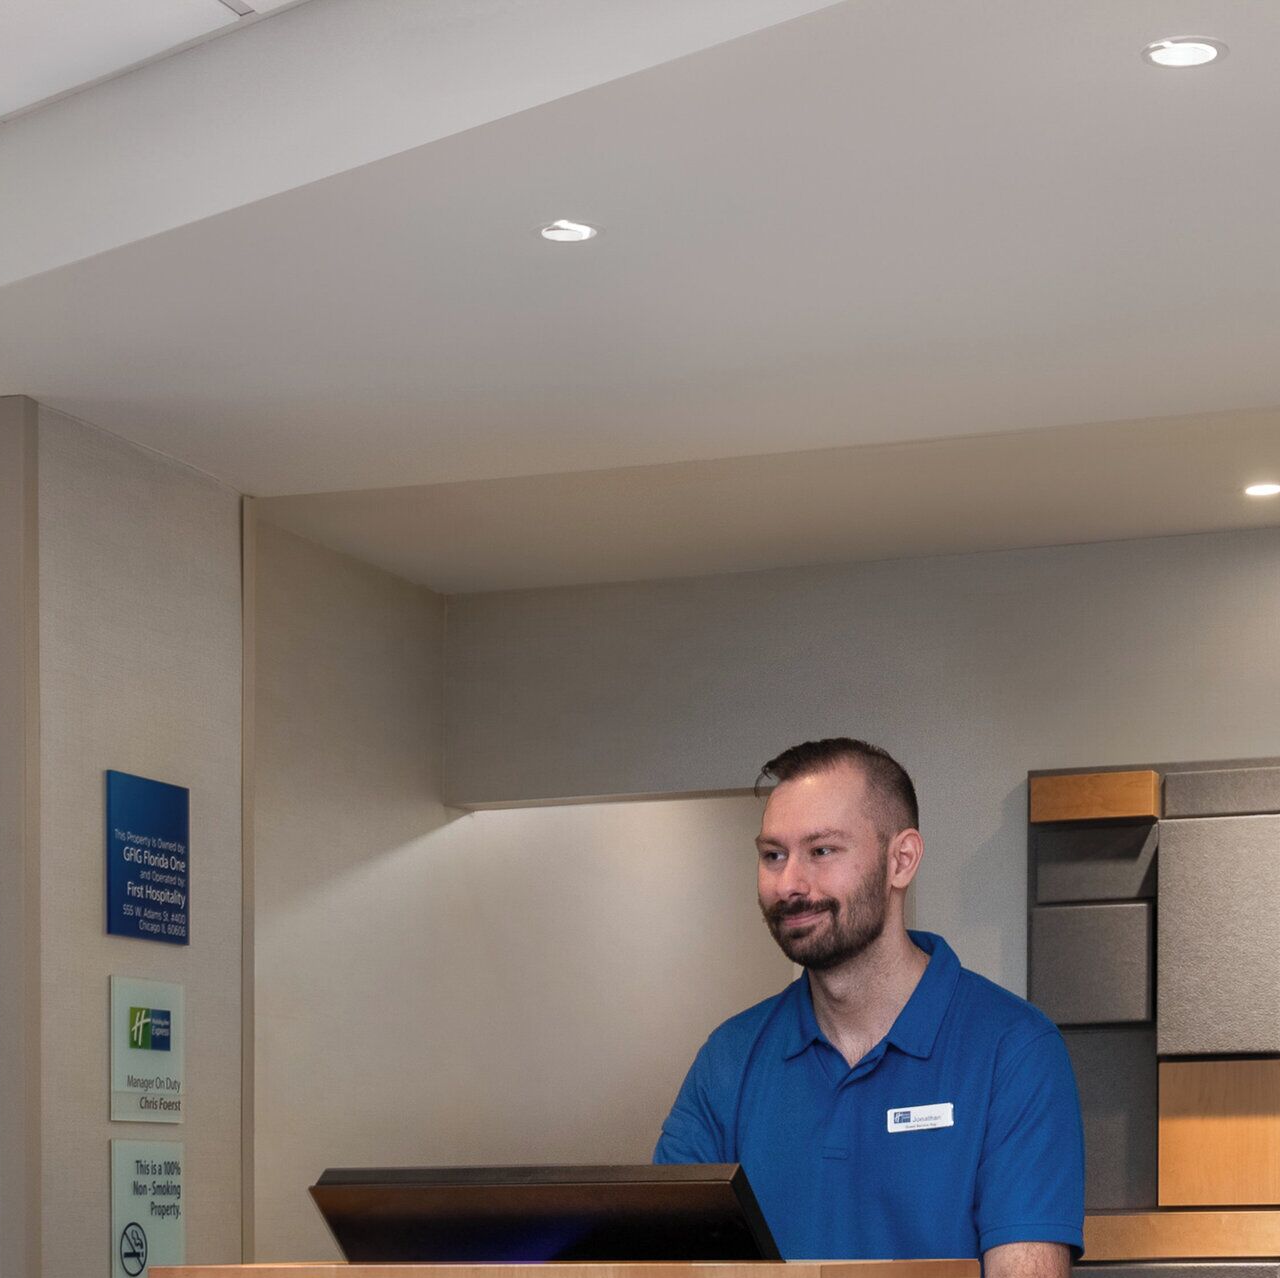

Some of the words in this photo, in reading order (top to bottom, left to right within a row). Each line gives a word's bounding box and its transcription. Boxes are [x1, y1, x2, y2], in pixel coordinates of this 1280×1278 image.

[127, 832, 151, 848] Property
[143, 850, 168, 869] Florida
[169, 856, 186, 873] One
[140, 870, 151, 881] and
[127, 881, 144, 898] First
[145, 884, 186, 910] Hospitality
[138, 919, 161, 934] Chicago
[127, 1074, 155, 1092] Manager
[155, 1076, 165, 1090] On
[165, 1077, 181, 1093] Duty
[140, 1096, 158, 1110] Chris
[159, 1097, 181, 1111] Foerst
[135, 1160, 150, 1175] This
[150, 1160, 157, 1175] is
[163, 1161, 181, 1175] 100%
[132, 1180, 148, 1195] Non
[152, 1180, 181, 1199] Smoking
[150, 1201, 181, 1220] Property.
